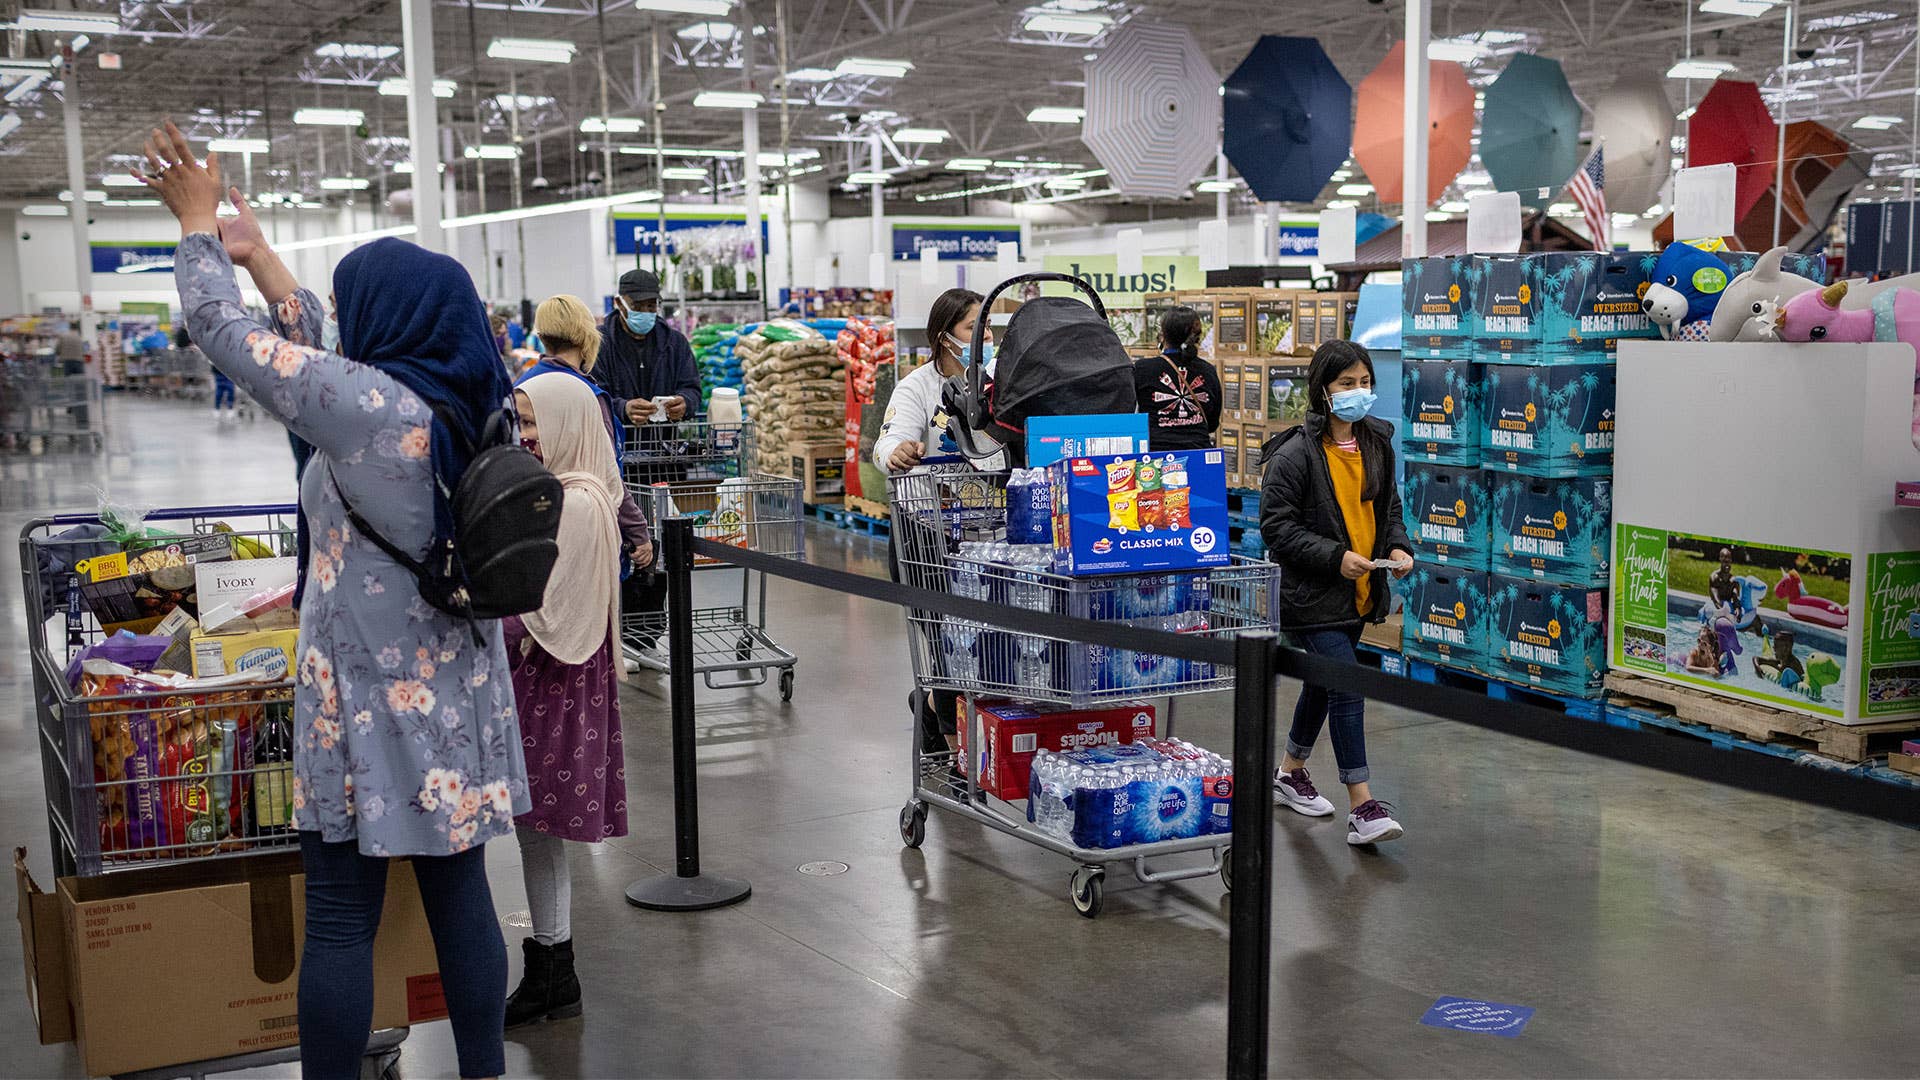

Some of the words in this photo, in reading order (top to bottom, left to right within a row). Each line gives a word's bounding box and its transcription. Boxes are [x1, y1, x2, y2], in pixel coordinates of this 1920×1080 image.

[1593, 303, 1639, 313] OVERSIZED
[1414, 315, 1436, 330] BEACH
[1436, 315, 1459, 330] TOWEL
[1485, 316, 1506, 332] BEACH
[1507, 317, 1529, 333] TOWEL
[1581, 315, 1615, 332] BEACH
[1413, 422, 1432, 439] BEACH
[1432, 424, 1452, 439] TOWEL
[1598, 421, 1614, 431] OVE
[1491, 429, 1512, 446] BEACH
[1512, 432, 1534, 449] TOWEL
[1585, 432, 1614, 449] BEAC
[1031, 495, 1050, 503] PUR
[1031, 502, 1050, 510] QUAL
[1033, 524, 1043, 532] 40
[1421, 522, 1442, 540] BEACH
[1442, 526, 1464, 543] TOWEL
[1120, 539, 1163, 550] CLASSIC
[1164, 537, 1184, 546] MIX
[1194, 532, 1212, 545] 50
[1513, 535, 1538, 554] BEACH
[1539, 539, 1564, 557] TOWEL
[98, 561, 116, 571] BBQ
[1623, 542, 1667, 579] Animal
[1630, 572, 1662, 607] Floats
[1872, 571, 1920, 611] Anim
[1421, 622, 1443, 641] BEACH
[1443, 626, 1465, 645] TOWEL
[235, 647, 284, 672] Famous
[1509, 640, 1534, 660] BEACH
[1534, 646, 1560, 666] TOWEL
[1060, 731, 1119, 747] HUGGIES
[1159, 801, 1171, 811] Pure
[1172, 799, 1186, 811] Life
[201, 825, 212, 833] 8
[1113, 829, 1121, 837] 40
[84, 905, 111, 916] VENDOR
[112, 903, 125, 912] STK
[106, 926, 124, 936] CLUB
[125, 924, 141, 934] ITEM
[228, 1000, 245, 1009] KEEP
[246, 996, 273, 1006] FROZEN
[1444, 1007, 1474, 1015] apart
[1469, 1016, 1505, 1024] Please
[239, 1037, 259, 1048] PHILLY
[260, 1031, 299, 1044] CHEESESTEA
